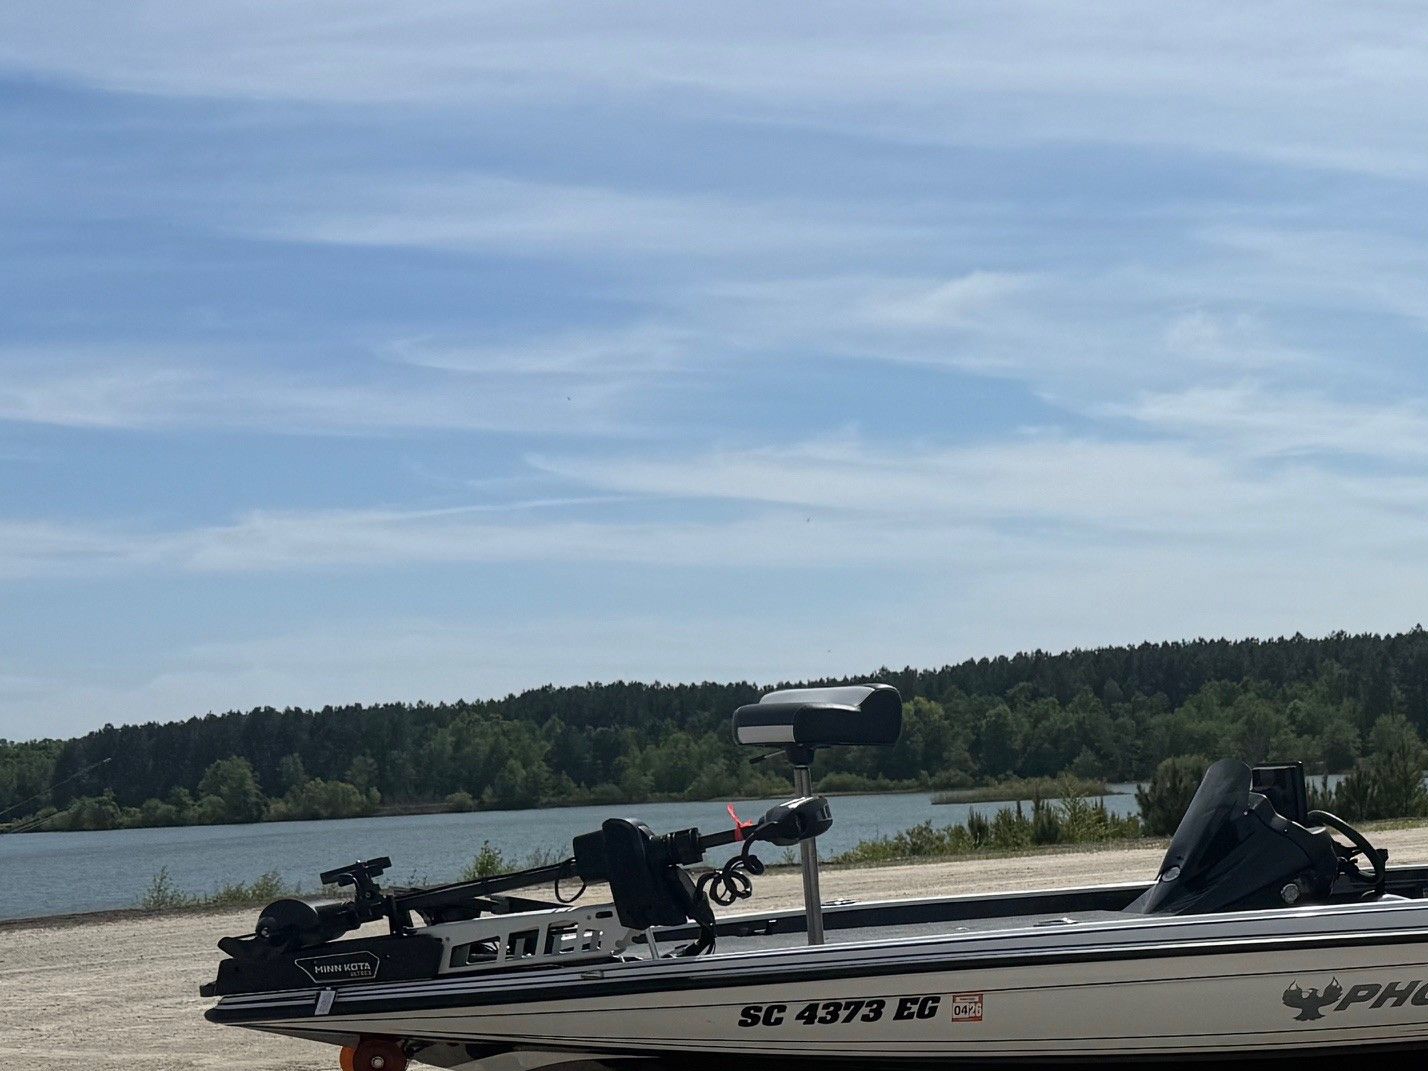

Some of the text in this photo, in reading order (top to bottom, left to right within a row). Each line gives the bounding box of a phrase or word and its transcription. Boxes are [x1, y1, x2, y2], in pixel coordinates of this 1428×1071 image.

[314, 962, 371, 973] MINN KOTA
[738, 996, 941, 1027] SC 4373 EG
